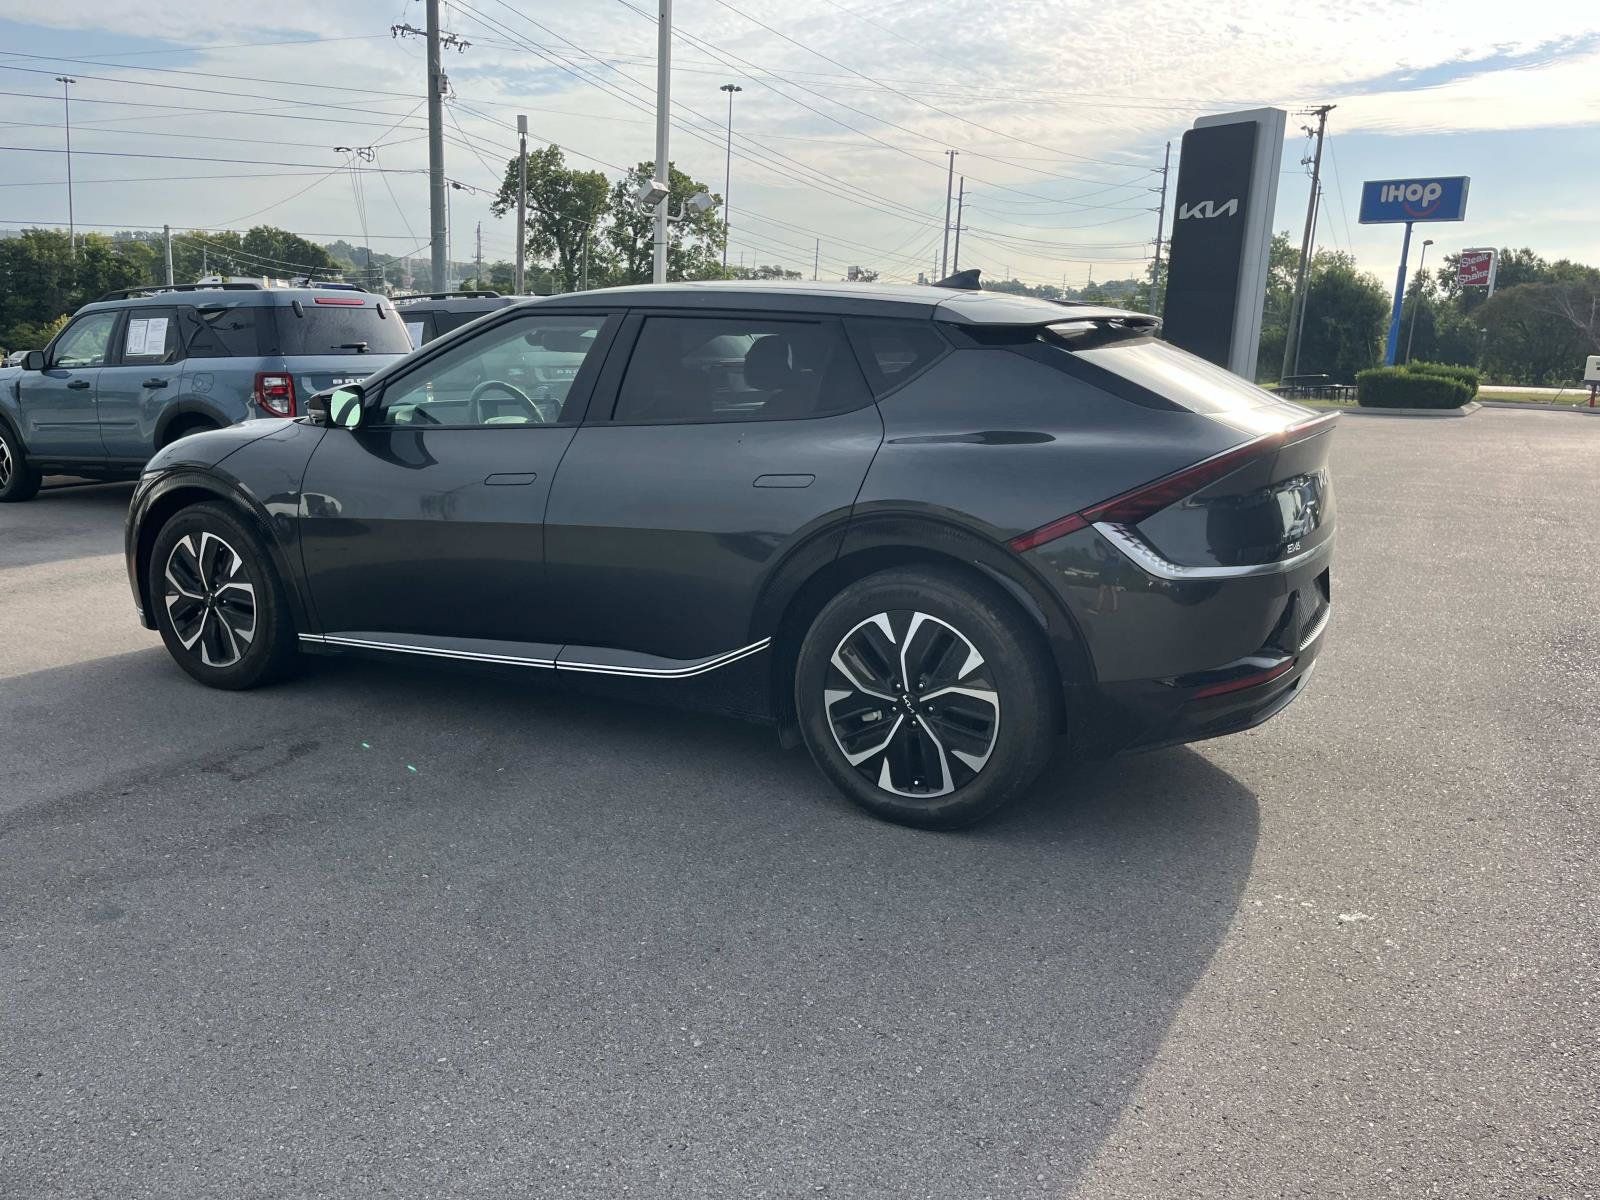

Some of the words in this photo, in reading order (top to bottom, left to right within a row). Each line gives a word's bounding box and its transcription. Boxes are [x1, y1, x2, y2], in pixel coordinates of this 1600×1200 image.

[1381, 183, 1442, 207] IHOP
[1179, 199, 1239, 220] KIA
[1461, 253, 1489, 268] Steak
[1458, 270, 1489, 285] Shake
